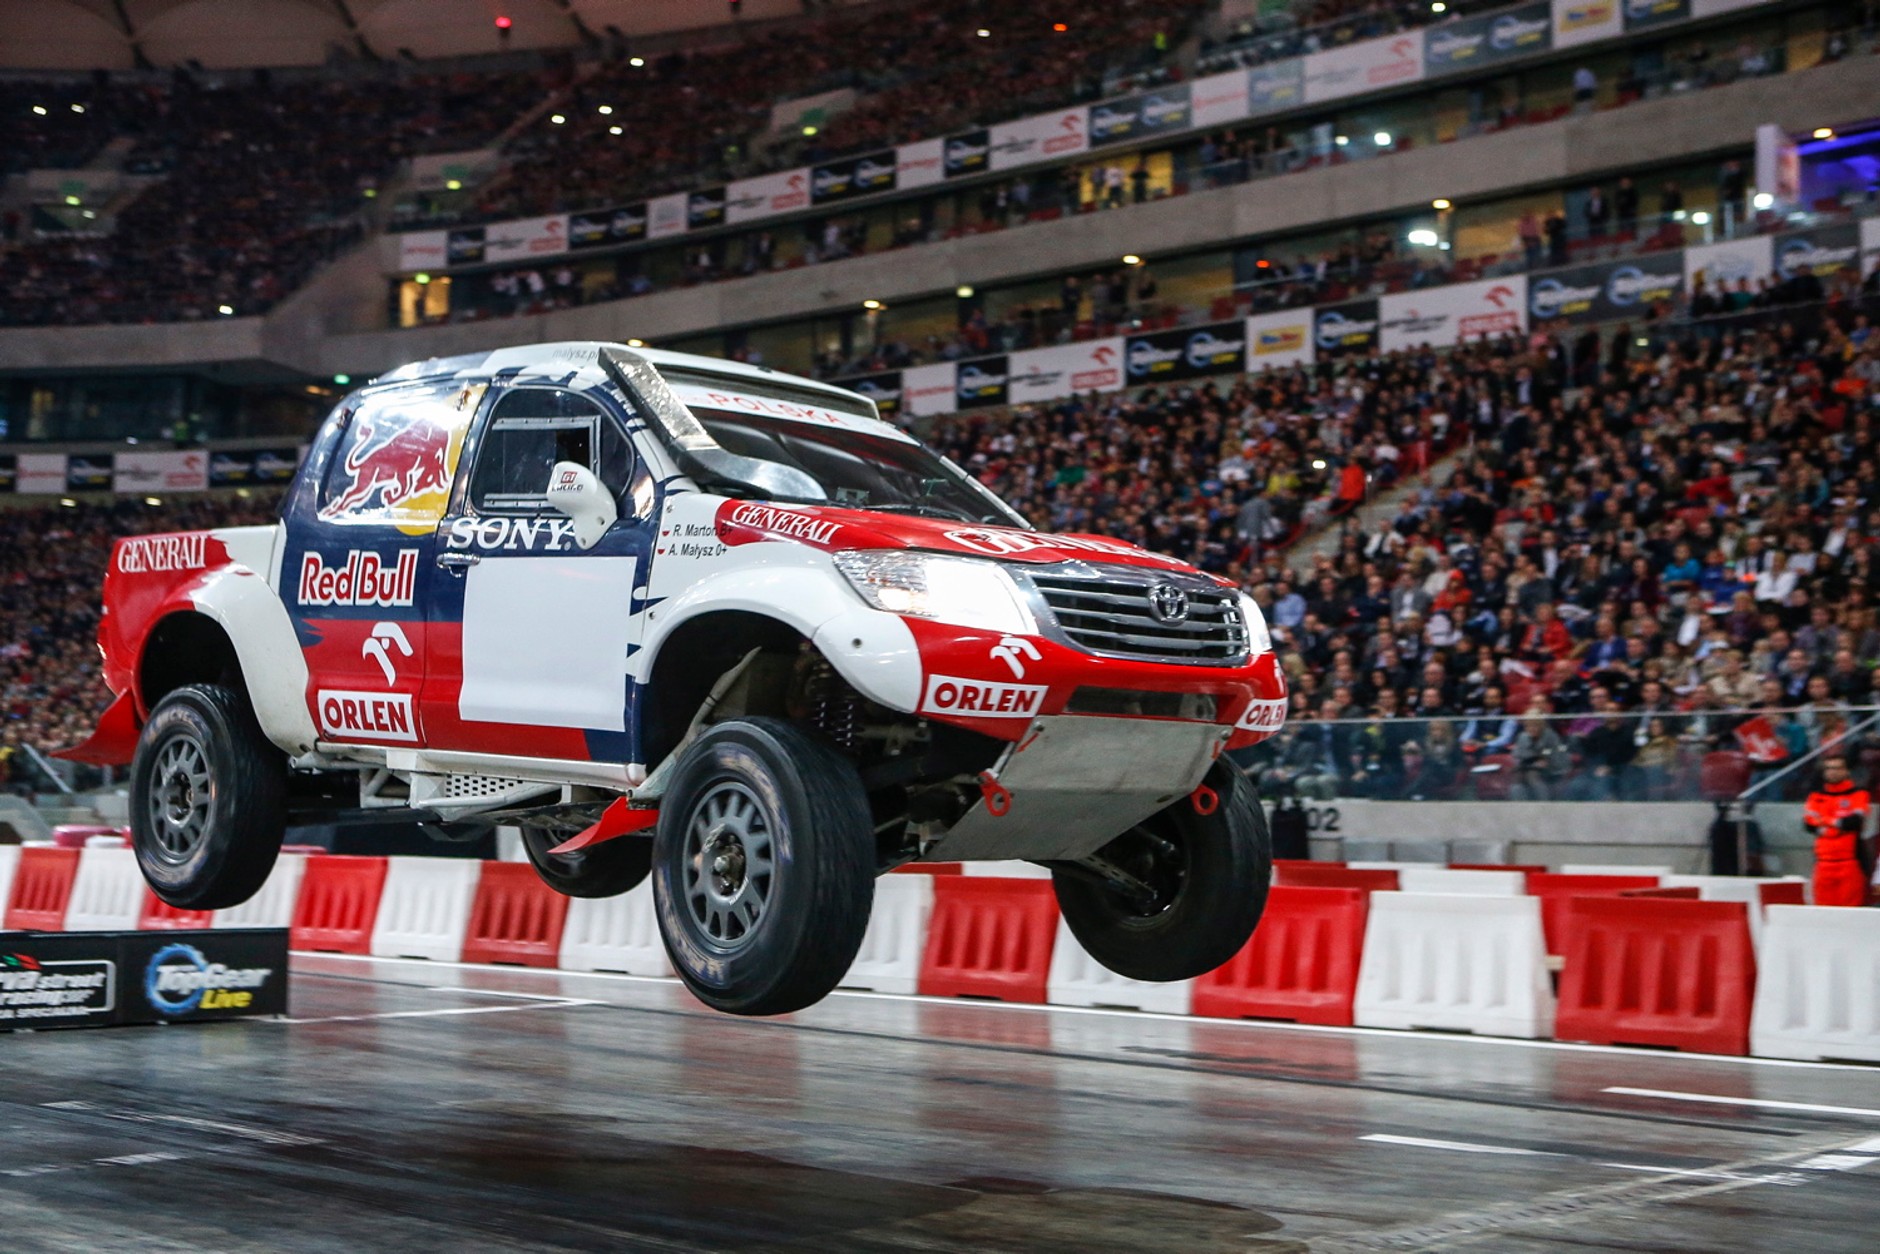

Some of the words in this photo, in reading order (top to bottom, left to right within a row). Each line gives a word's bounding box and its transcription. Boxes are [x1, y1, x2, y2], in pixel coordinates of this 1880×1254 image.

[447, 517, 574, 550] SONY
[672, 524, 682, 537] R.
[685, 524, 717, 537] Marton
[732, 504, 844, 545] GENERALI
[117, 535, 206, 573] GENERALI
[668, 544, 678, 556] A.
[298, 550, 359, 605] Red
[356, 549, 419, 606] Bull
[935, 682, 1039, 713] ORLEN
[324, 697, 410, 734] ORLEN
[199, 989, 253, 1009] Live
